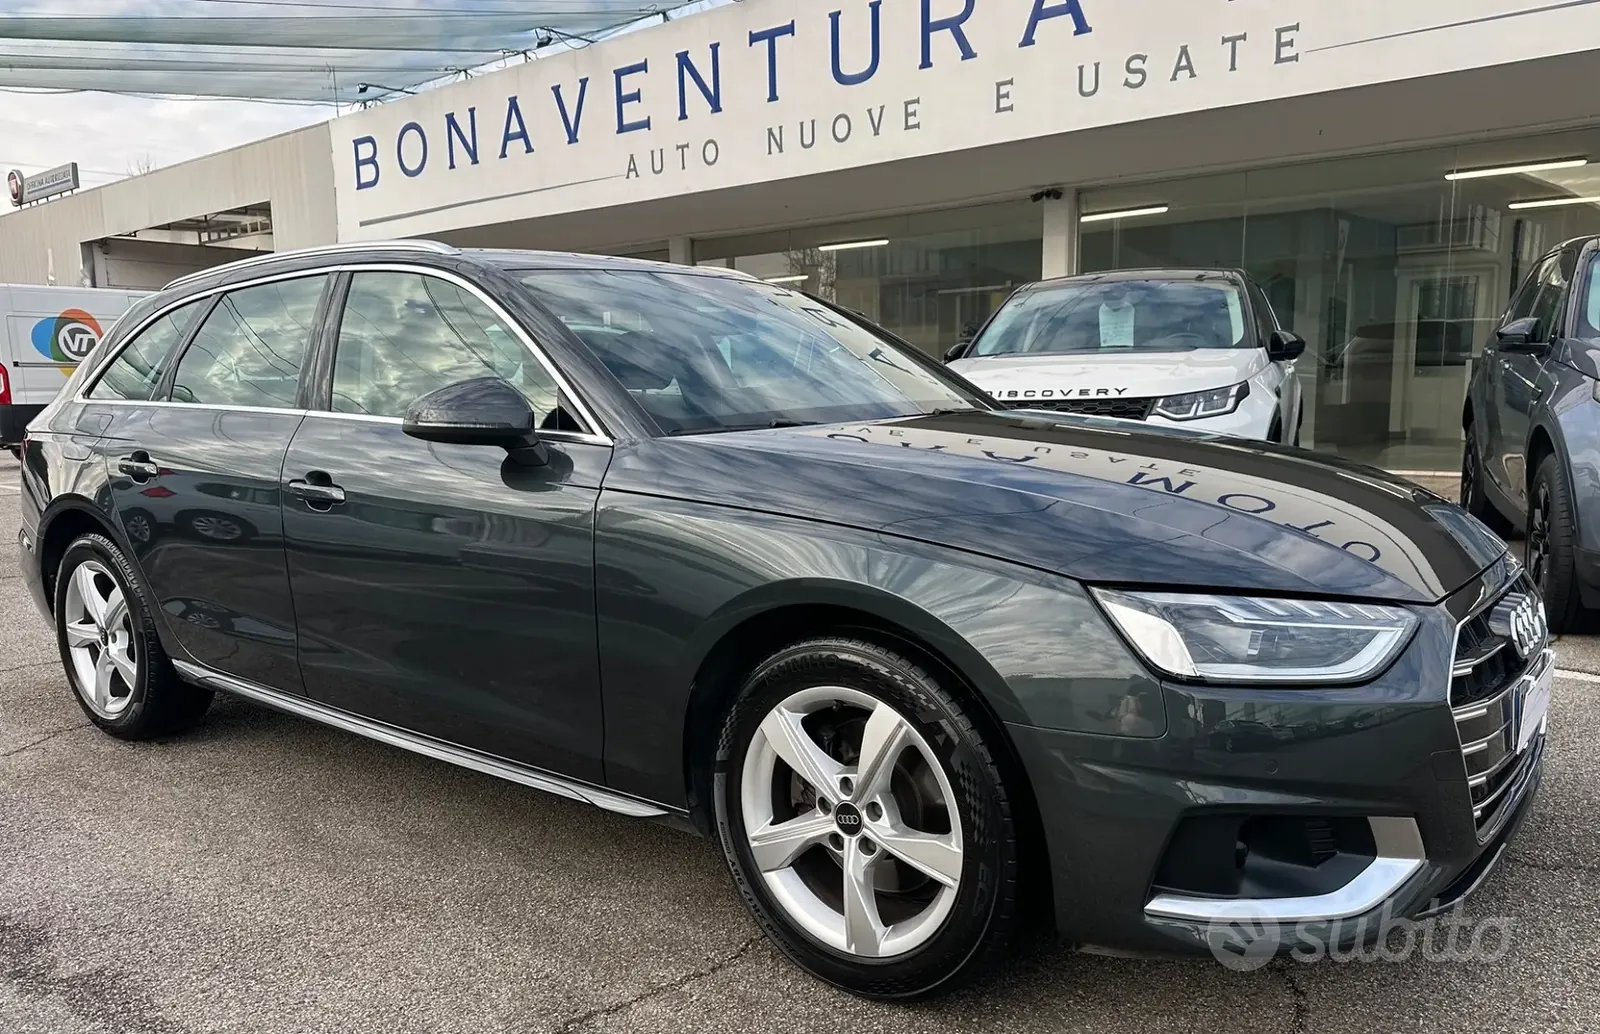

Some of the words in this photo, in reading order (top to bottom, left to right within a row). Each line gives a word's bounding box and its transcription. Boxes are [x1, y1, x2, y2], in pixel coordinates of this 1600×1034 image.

[626, 139, 719, 180] AUTO
[766, 97, 921, 156] NUOVE
[994, 78, 1015, 113] E
[1077, 22, 1301, 97] USATE
